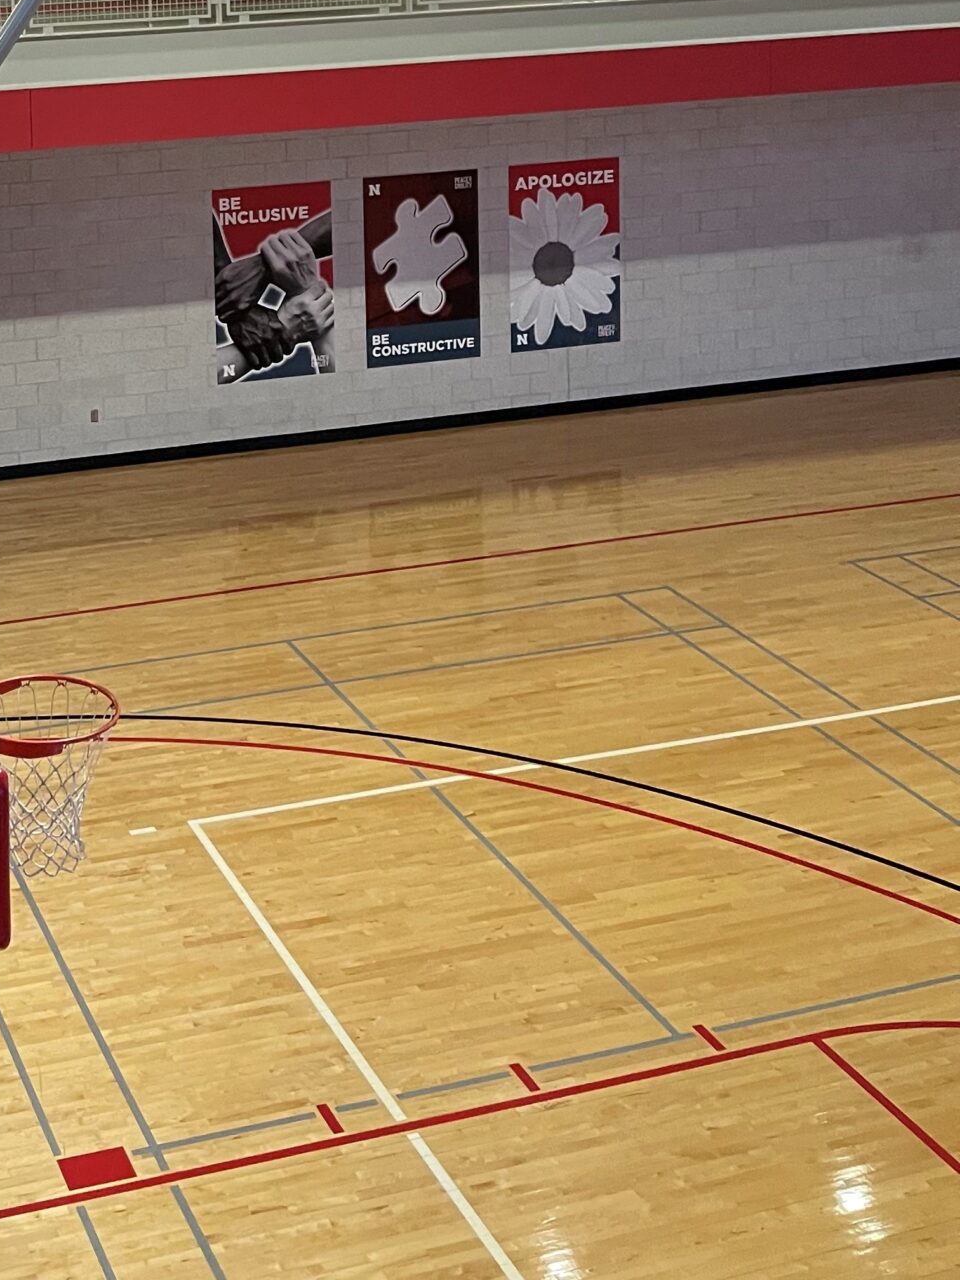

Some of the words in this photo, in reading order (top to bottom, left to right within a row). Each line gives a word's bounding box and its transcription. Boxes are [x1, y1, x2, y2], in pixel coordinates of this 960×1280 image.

[514, 169, 614, 191] APOLOGIZE
[368, 183, 381, 196] N
[219, 197, 241, 211] BE
[218, 205, 309, 225] INCLUSIVE
[372, 334, 389, 346] BE
[516, 333, 528, 346] N
[372, 337, 475, 358] CONSTRUCTIVE
[222, 364, 235, 377] N
